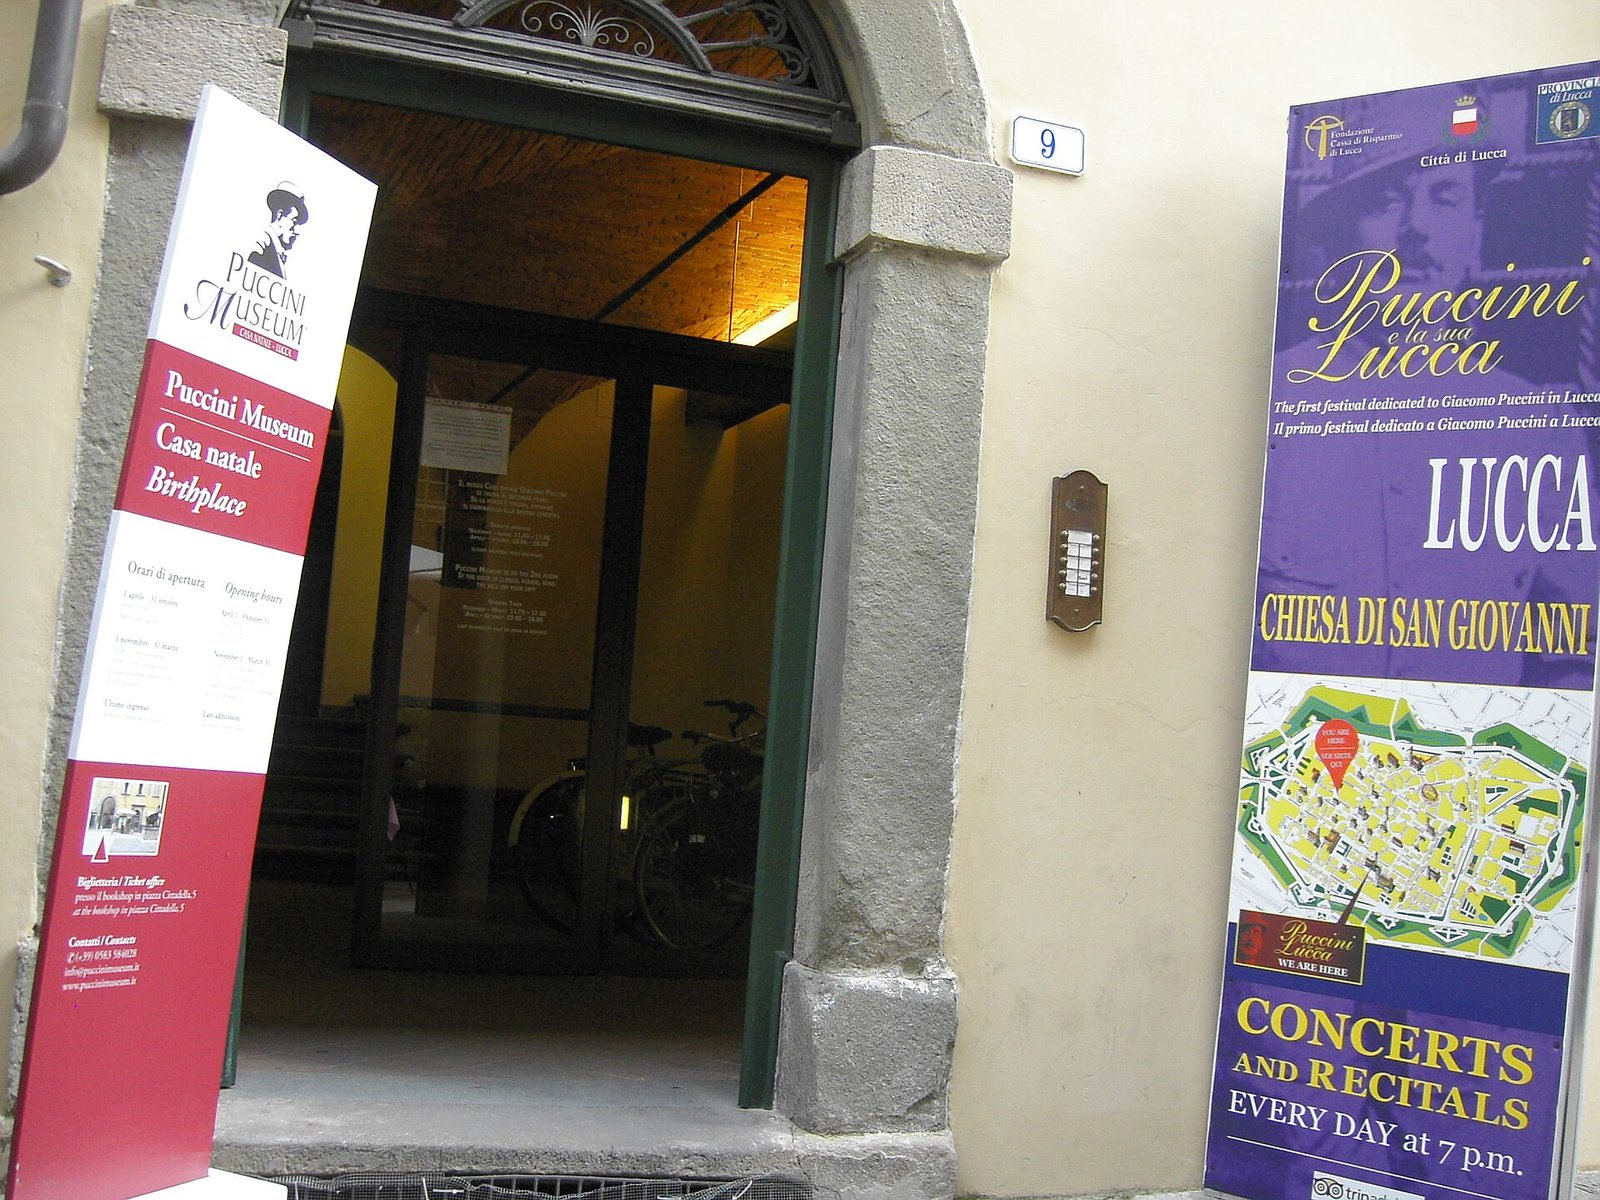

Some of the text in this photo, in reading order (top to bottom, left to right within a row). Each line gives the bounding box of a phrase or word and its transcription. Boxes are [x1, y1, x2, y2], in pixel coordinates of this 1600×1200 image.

[1539, 78, 1600, 95] PROVINCI
[1550, 90, 1592, 104] di Lucca
[1040, 128, 1056, 159] 9
[1330, 127, 1375, 138] Fondazione
[1353, 135, 1362, 146] di
[1363, 130, 1403, 145] Risparmio
[1329, 146, 1362, 157] di Lucca
[1420, 148, 1507, 168] Città di Lucca
[226, 251, 306, 317] PUCCINI
[1307, 248, 1591, 332] Puccini
[183, 279, 304, 345] MUSEUM
[1287, 300, 1504, 384] Lucca
[1388, 319, 1475, 345] e la sua
[164, 369, 315, 449] Puccini Museum
[1274, 390, 1600, 416] The first festival dedicated to Giacomo Puccini in Lucca
[1273, 413, 1600, 438] Il primo festival dedicato a Giacomo Puccini a Lucca
[156, 422, 263, 479] Casa natale
[145, 465, 248, 517] Birthplace
[1423, 454, 1597, 553] LUCCA
[127, 560, 205, 589] Orari di apertura
[225, 581, 283, 605] Opening hours
[1260, 593, 1591, 656] CHIESA DI SAN GIOVANNI
[1275, 934, 1333, 962] Lucca
[1280, 919, 1356, 951] Puccini
[1278, 958, 1349, 977] WE ARE HERE
[1236, 997, 1534, 1086] CONCERTS
[1232, 1052, 1530, 1131] AND RECITALS
[1227, 1089, 1523, 1177] EVERY DAY at 7 p.m.
